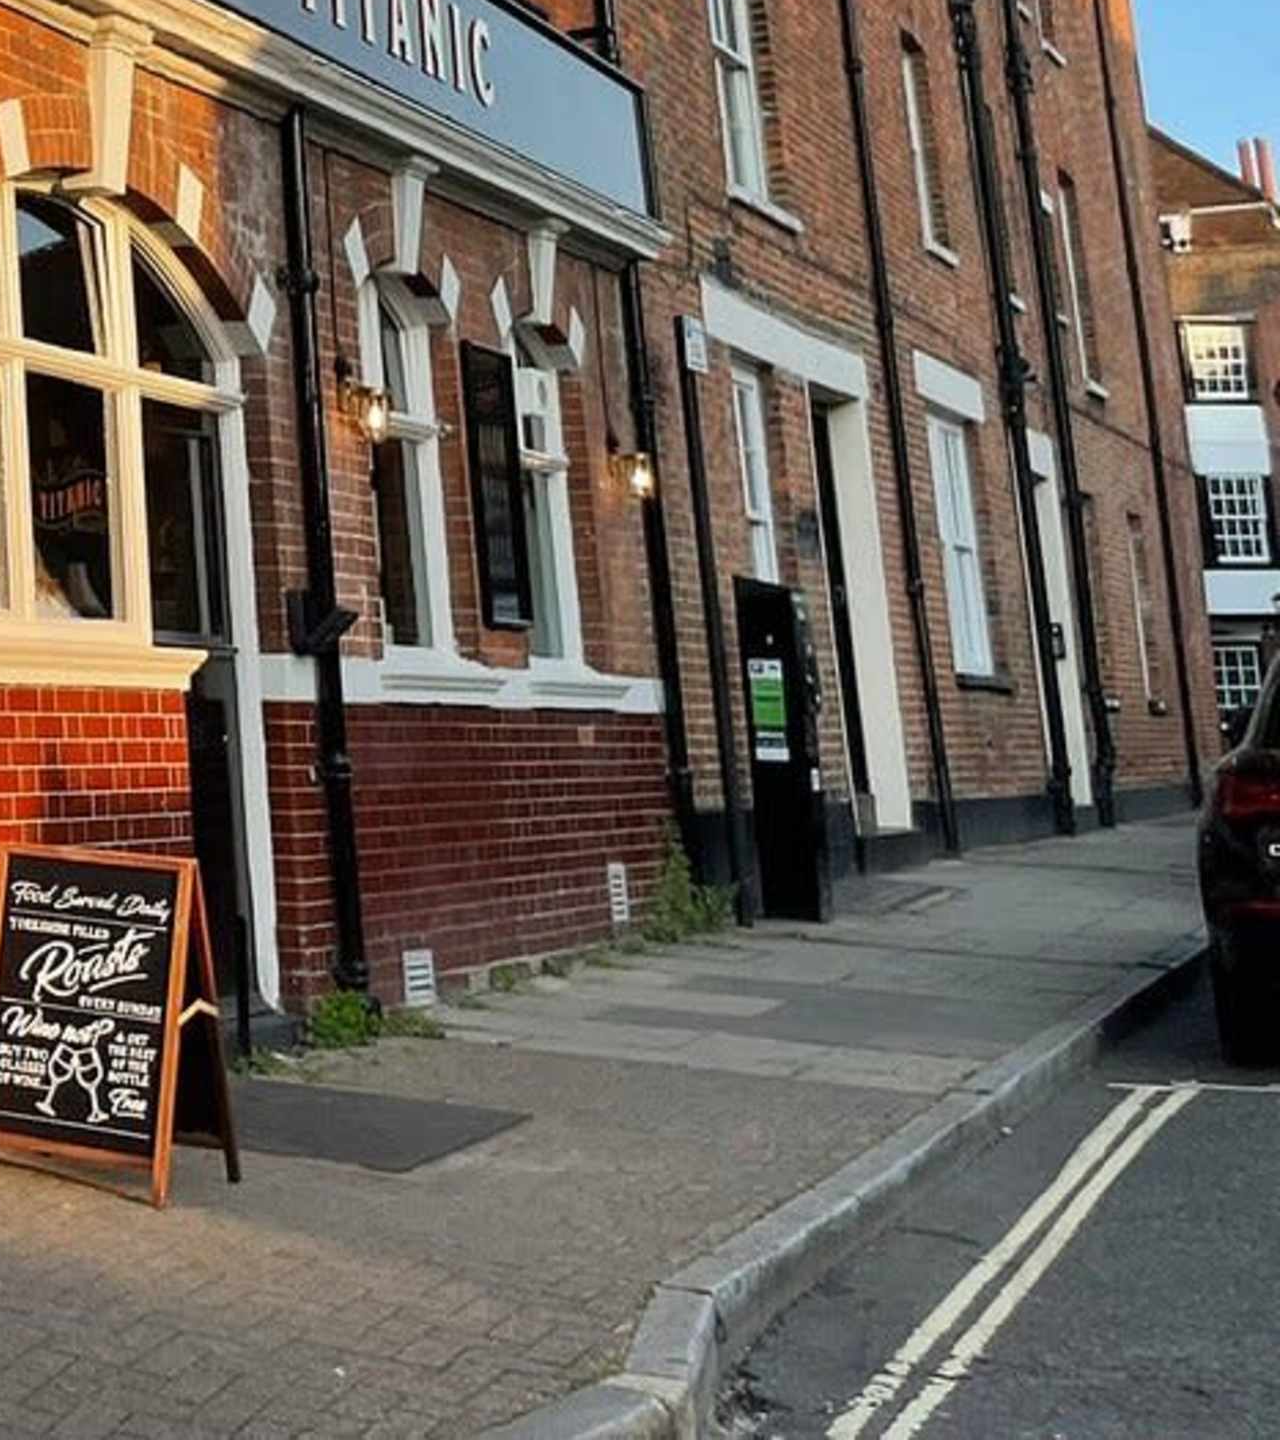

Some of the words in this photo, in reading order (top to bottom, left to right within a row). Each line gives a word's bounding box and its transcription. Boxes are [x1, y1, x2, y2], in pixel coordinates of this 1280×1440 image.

[38, 475, 103, 522] TITANIC
[10, 880, 59, 905] Food
[53, 885, 119, 910] Served
[116, 893, 171, 925] Daily
[19, 928, 156, 1003] Roasts
